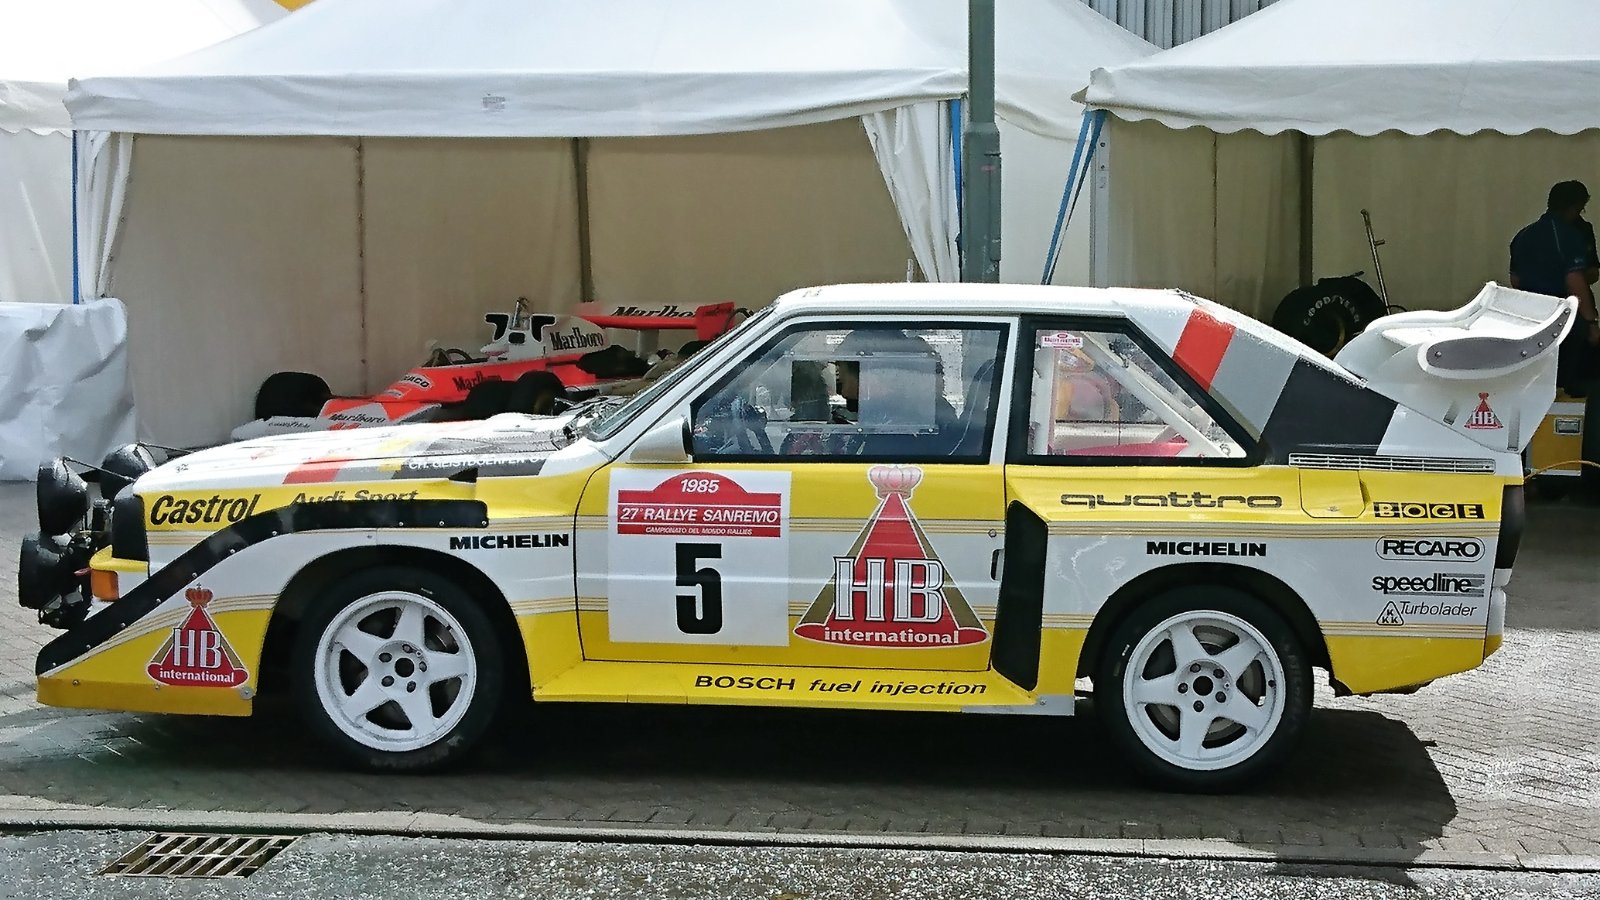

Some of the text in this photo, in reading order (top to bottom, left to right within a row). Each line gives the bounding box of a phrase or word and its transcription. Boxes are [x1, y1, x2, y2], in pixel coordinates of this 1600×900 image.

[611, 305, 695, 317] Marlbo
[550, 326, 604, 350] Marlboro
[1472, 411, 1495, 425] HB
[680, 478, 720, 494] 1985
[289, 489, 419, 504] Audi Sport
[1060, 491, 1282, 509] quattro
[150, 493, 262, 526] Castrol
[644, 508, 698, 522] RALLYE
[702, 509, 778, 523] SANREMO
[1374, 502, 1484, 519] BOGE
[645, 526, 687, 534] CAMPIONATO
[449, 533, 569, 550] MICHELIN
[1146, 541, 1267, 556] MICHELIN
[1383, 540, 1480, 558] RECARO
[676, 543, 723, 635] 5
[832, 556, 945, 623] HB
[1372, 573, 1472, 595] speedline
[1400, 600, 1477, 616] Turbolader
[824, 627, 959, 644] international
[173, 628, 222, 669] HB
[160, 668, 234, 683] international
[695, 675, 987, 696] BOSCH fuel injection
